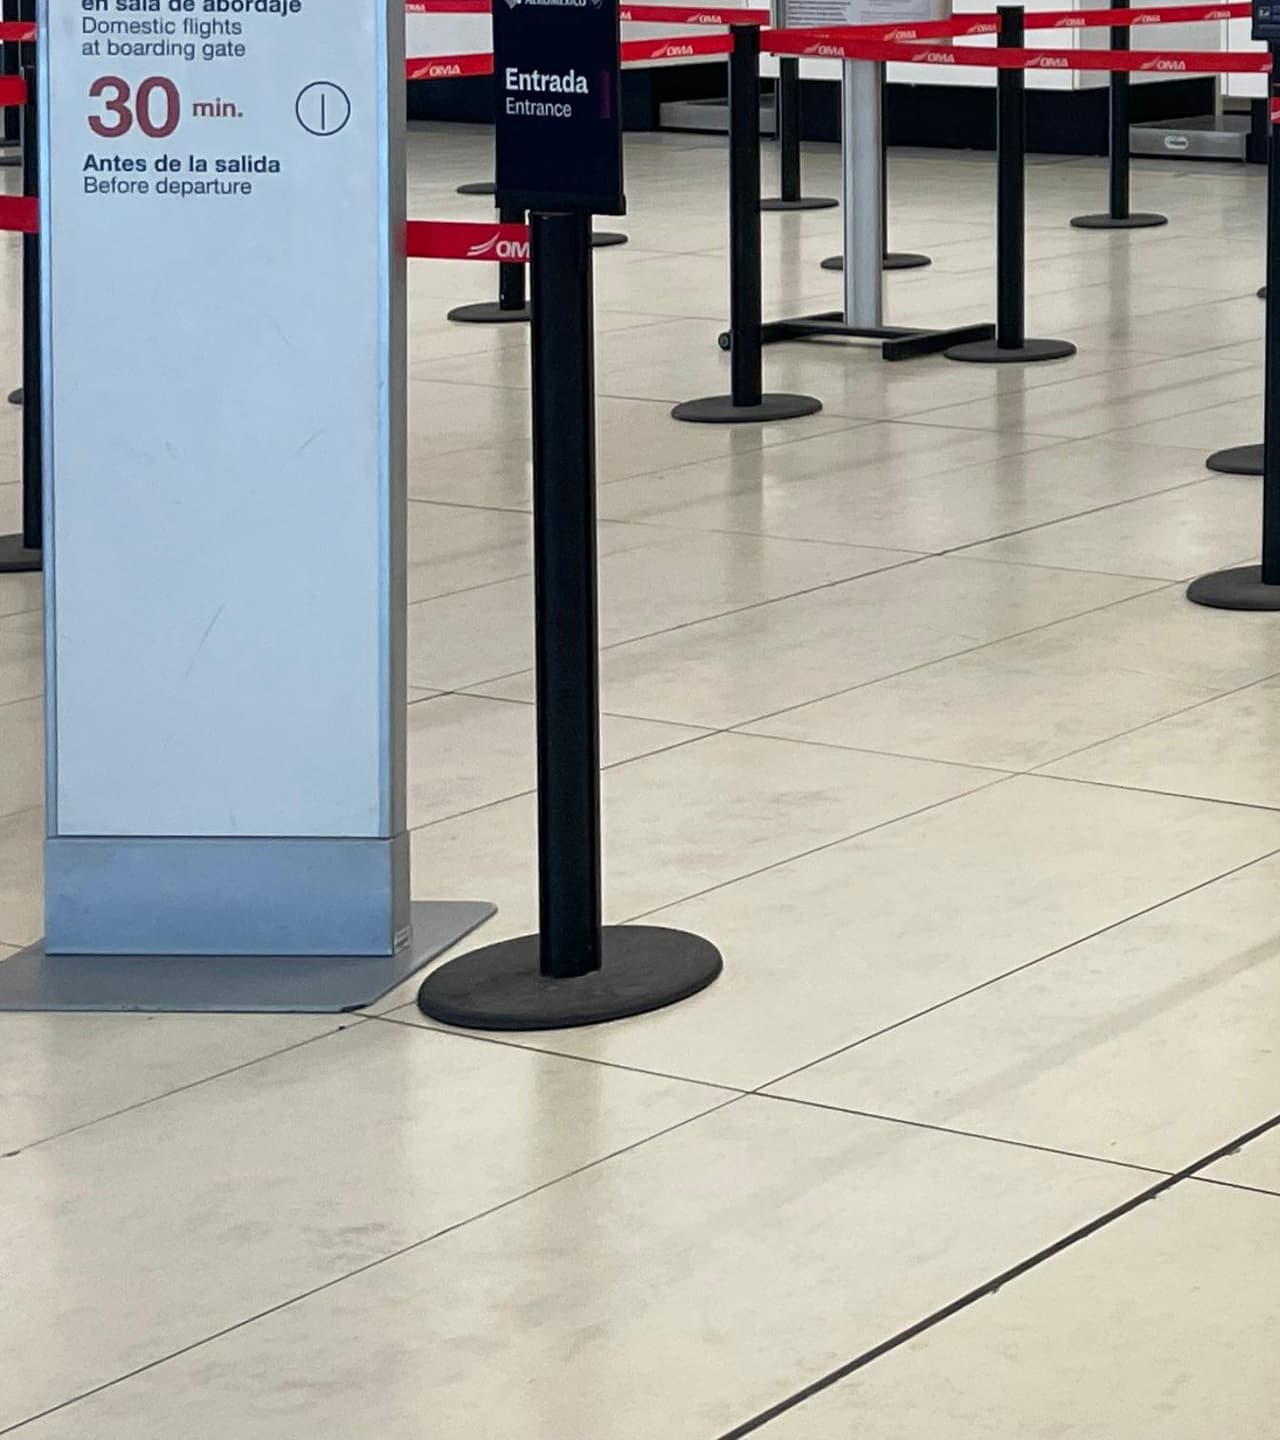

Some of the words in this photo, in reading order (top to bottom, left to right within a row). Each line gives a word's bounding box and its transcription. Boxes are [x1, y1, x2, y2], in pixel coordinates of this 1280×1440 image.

[82, 17, 176, 36] Domestic
[183, 18, 242, 40] flights
[82, 42, 100, 56] at
[107, 40, 195, 60] boarding
[202, 42, 246, 60] gate
[430, 65, 460, 77] OMA
[666, 45, 693, 56] OMA
[818, 45, 845, 56] OMA
[927, 53, 955, 63] OMA
[1040, 57, 1068, 68] OMA
[1156, 60, 1186, 71] OMA
[506, 68, 589, 94] Entrada
[88, 76, 180, 139] 30
[192, 101, 243, 118] min.
[506, 97, 572, 118] Entrance
[83, 155, 147, 173] Antes
[154, 155, 182, 174] de
[188, 155, 208, 173] la
[214, 156, 281, 174] salida
[84, 178, 149, 195] Before
[155, 178, 252, 199] departure
[496, 240, 530, 258] OM
